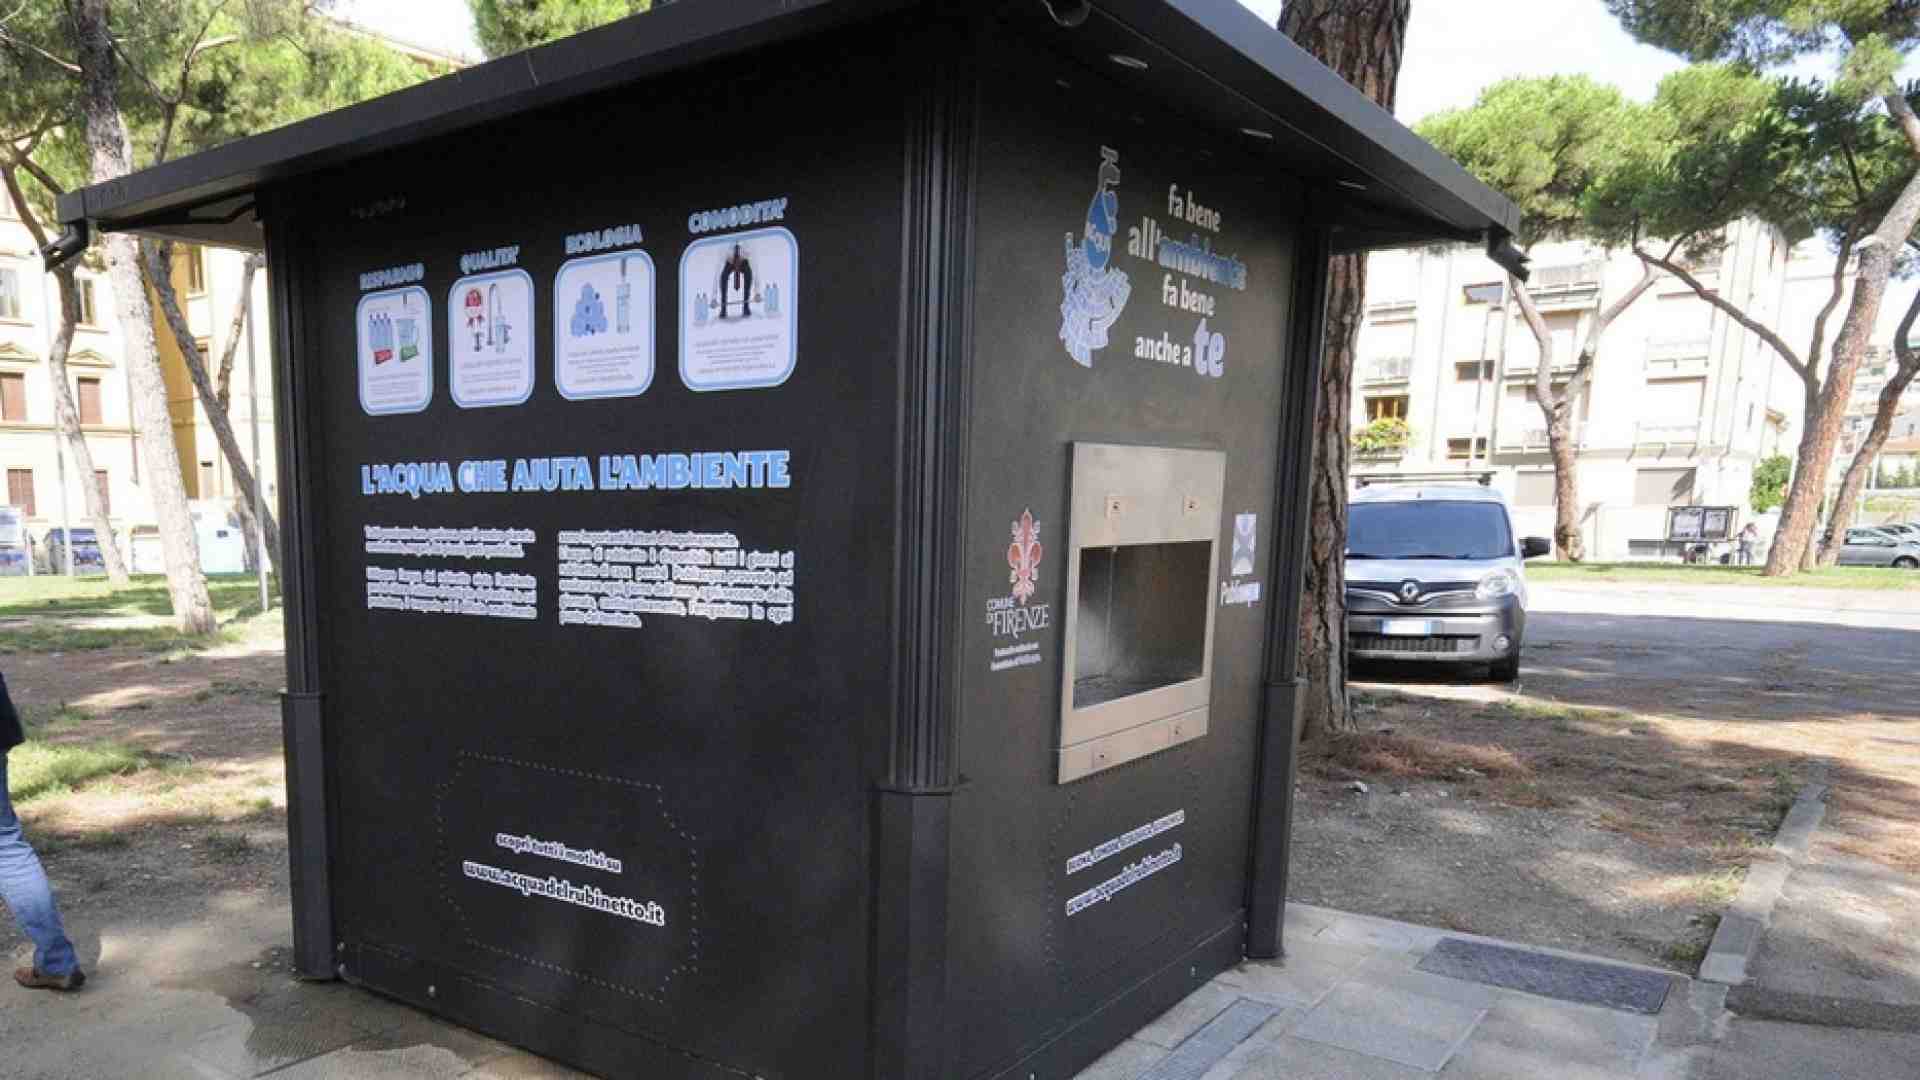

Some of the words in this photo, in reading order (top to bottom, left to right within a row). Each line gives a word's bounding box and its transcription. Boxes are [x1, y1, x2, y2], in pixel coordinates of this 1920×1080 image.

[1168, 183, 1184, 219] fa
[1185, 192, 1221, 233] bene
[1162, 273, 1178, 307] fa
[1180, 280, 1216, 317] bene
[1134, 332, 1181, 367] anche
[1181, 346, 1192, 368] a
[1193, 317, 1226, 378] te
[360, 463, 455, 499] L'ACQUA
[458, 459, 508, 492] CHE
[511, 456, 594, 492] AIUTA
[599, 449, 791, 491] L'AMBIENTE
[992, 604, 1049, 639] FIRENZE
[462, 859, 665, 926] www.acquadelrubinetto.it
